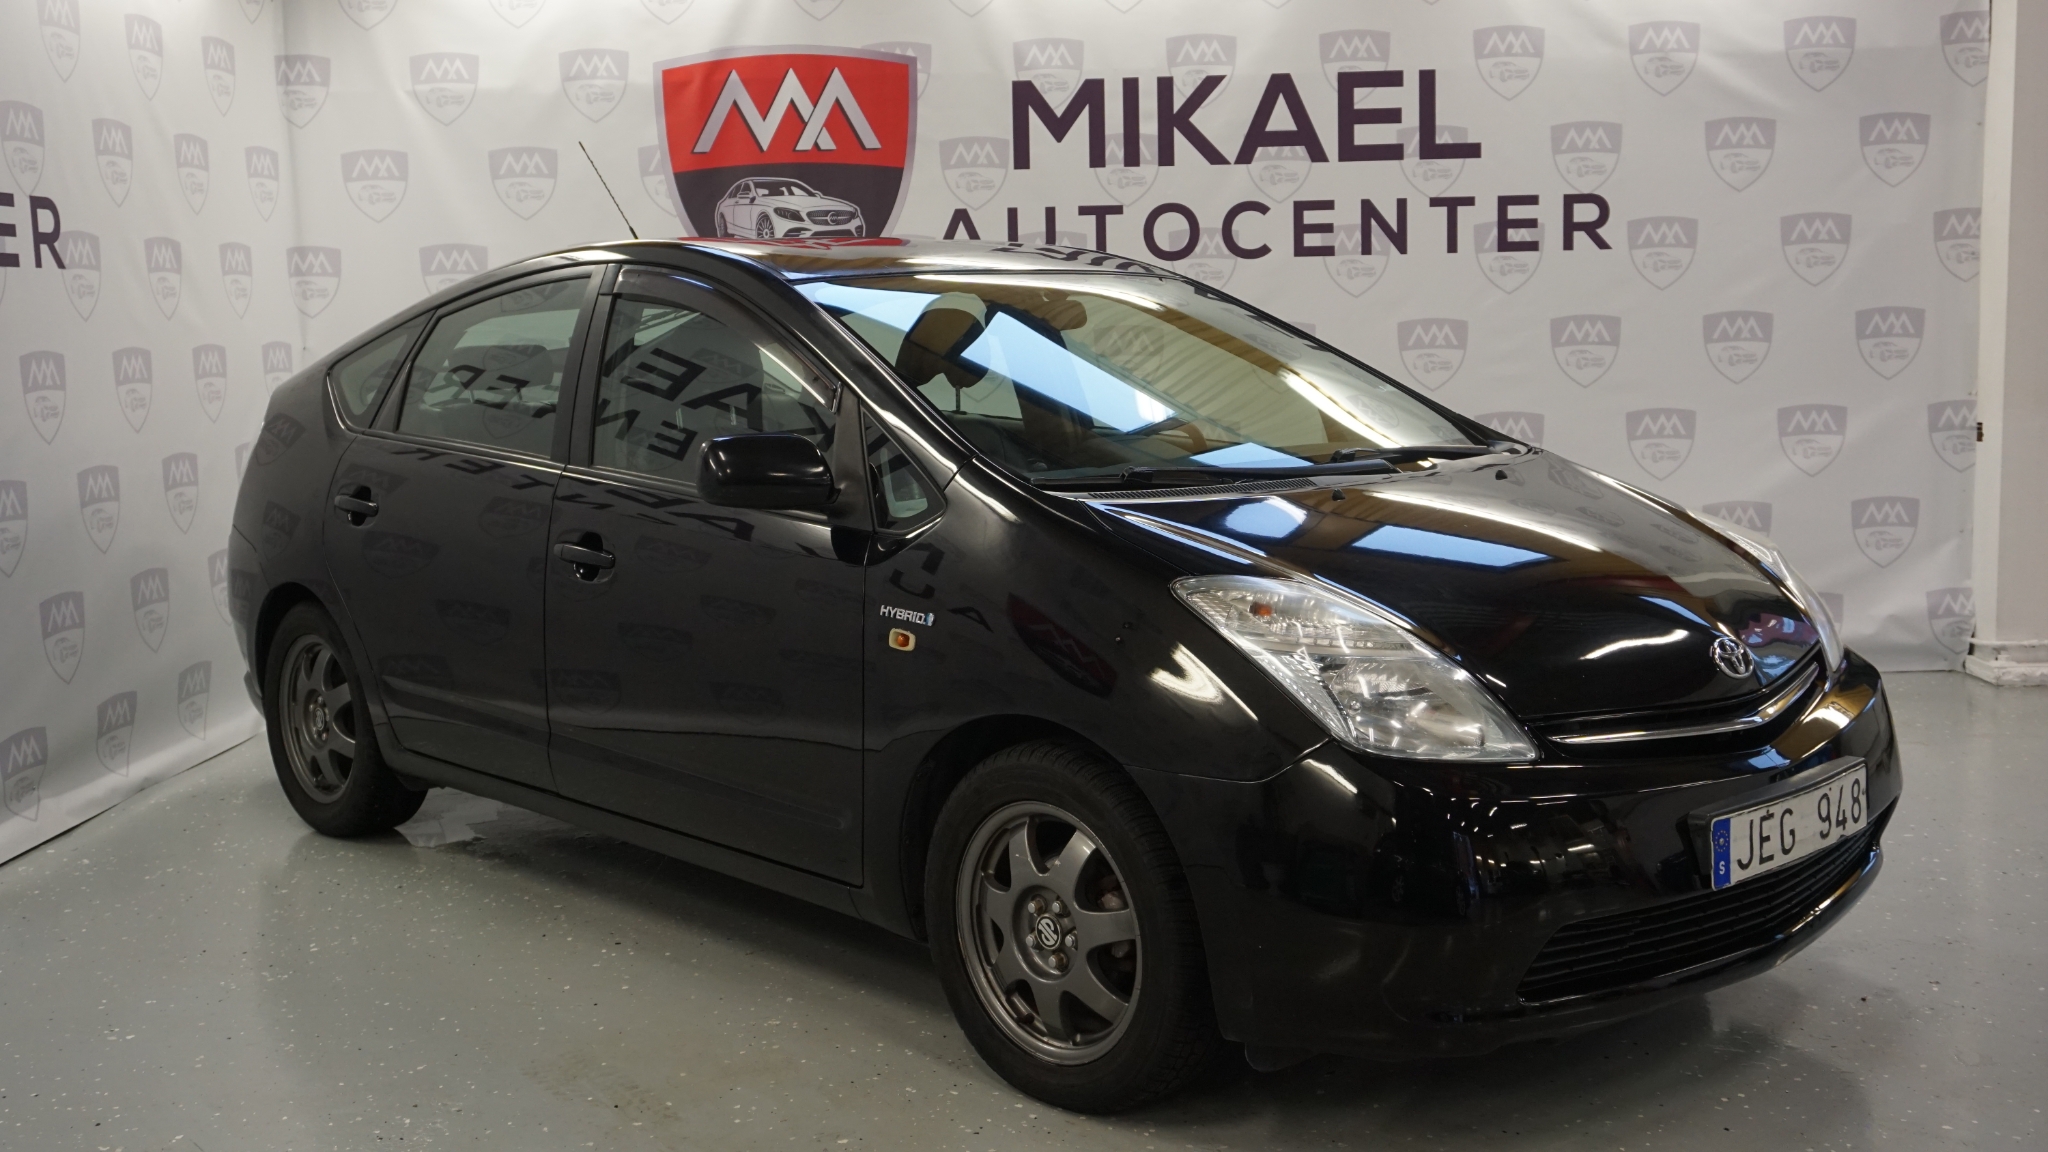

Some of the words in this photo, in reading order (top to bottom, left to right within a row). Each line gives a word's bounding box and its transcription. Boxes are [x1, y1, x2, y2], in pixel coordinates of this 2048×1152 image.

[1011, 69, 1482, 170] MIKAEL
[942, 192, 1613, 262] AUTOCENTER
[879, 604, 926, 625] HYBRID
[1736, 807, 1796, 871] JEG
[1817, 777, 1862, 840] 948
[1718, 860, 1726, 875] S
